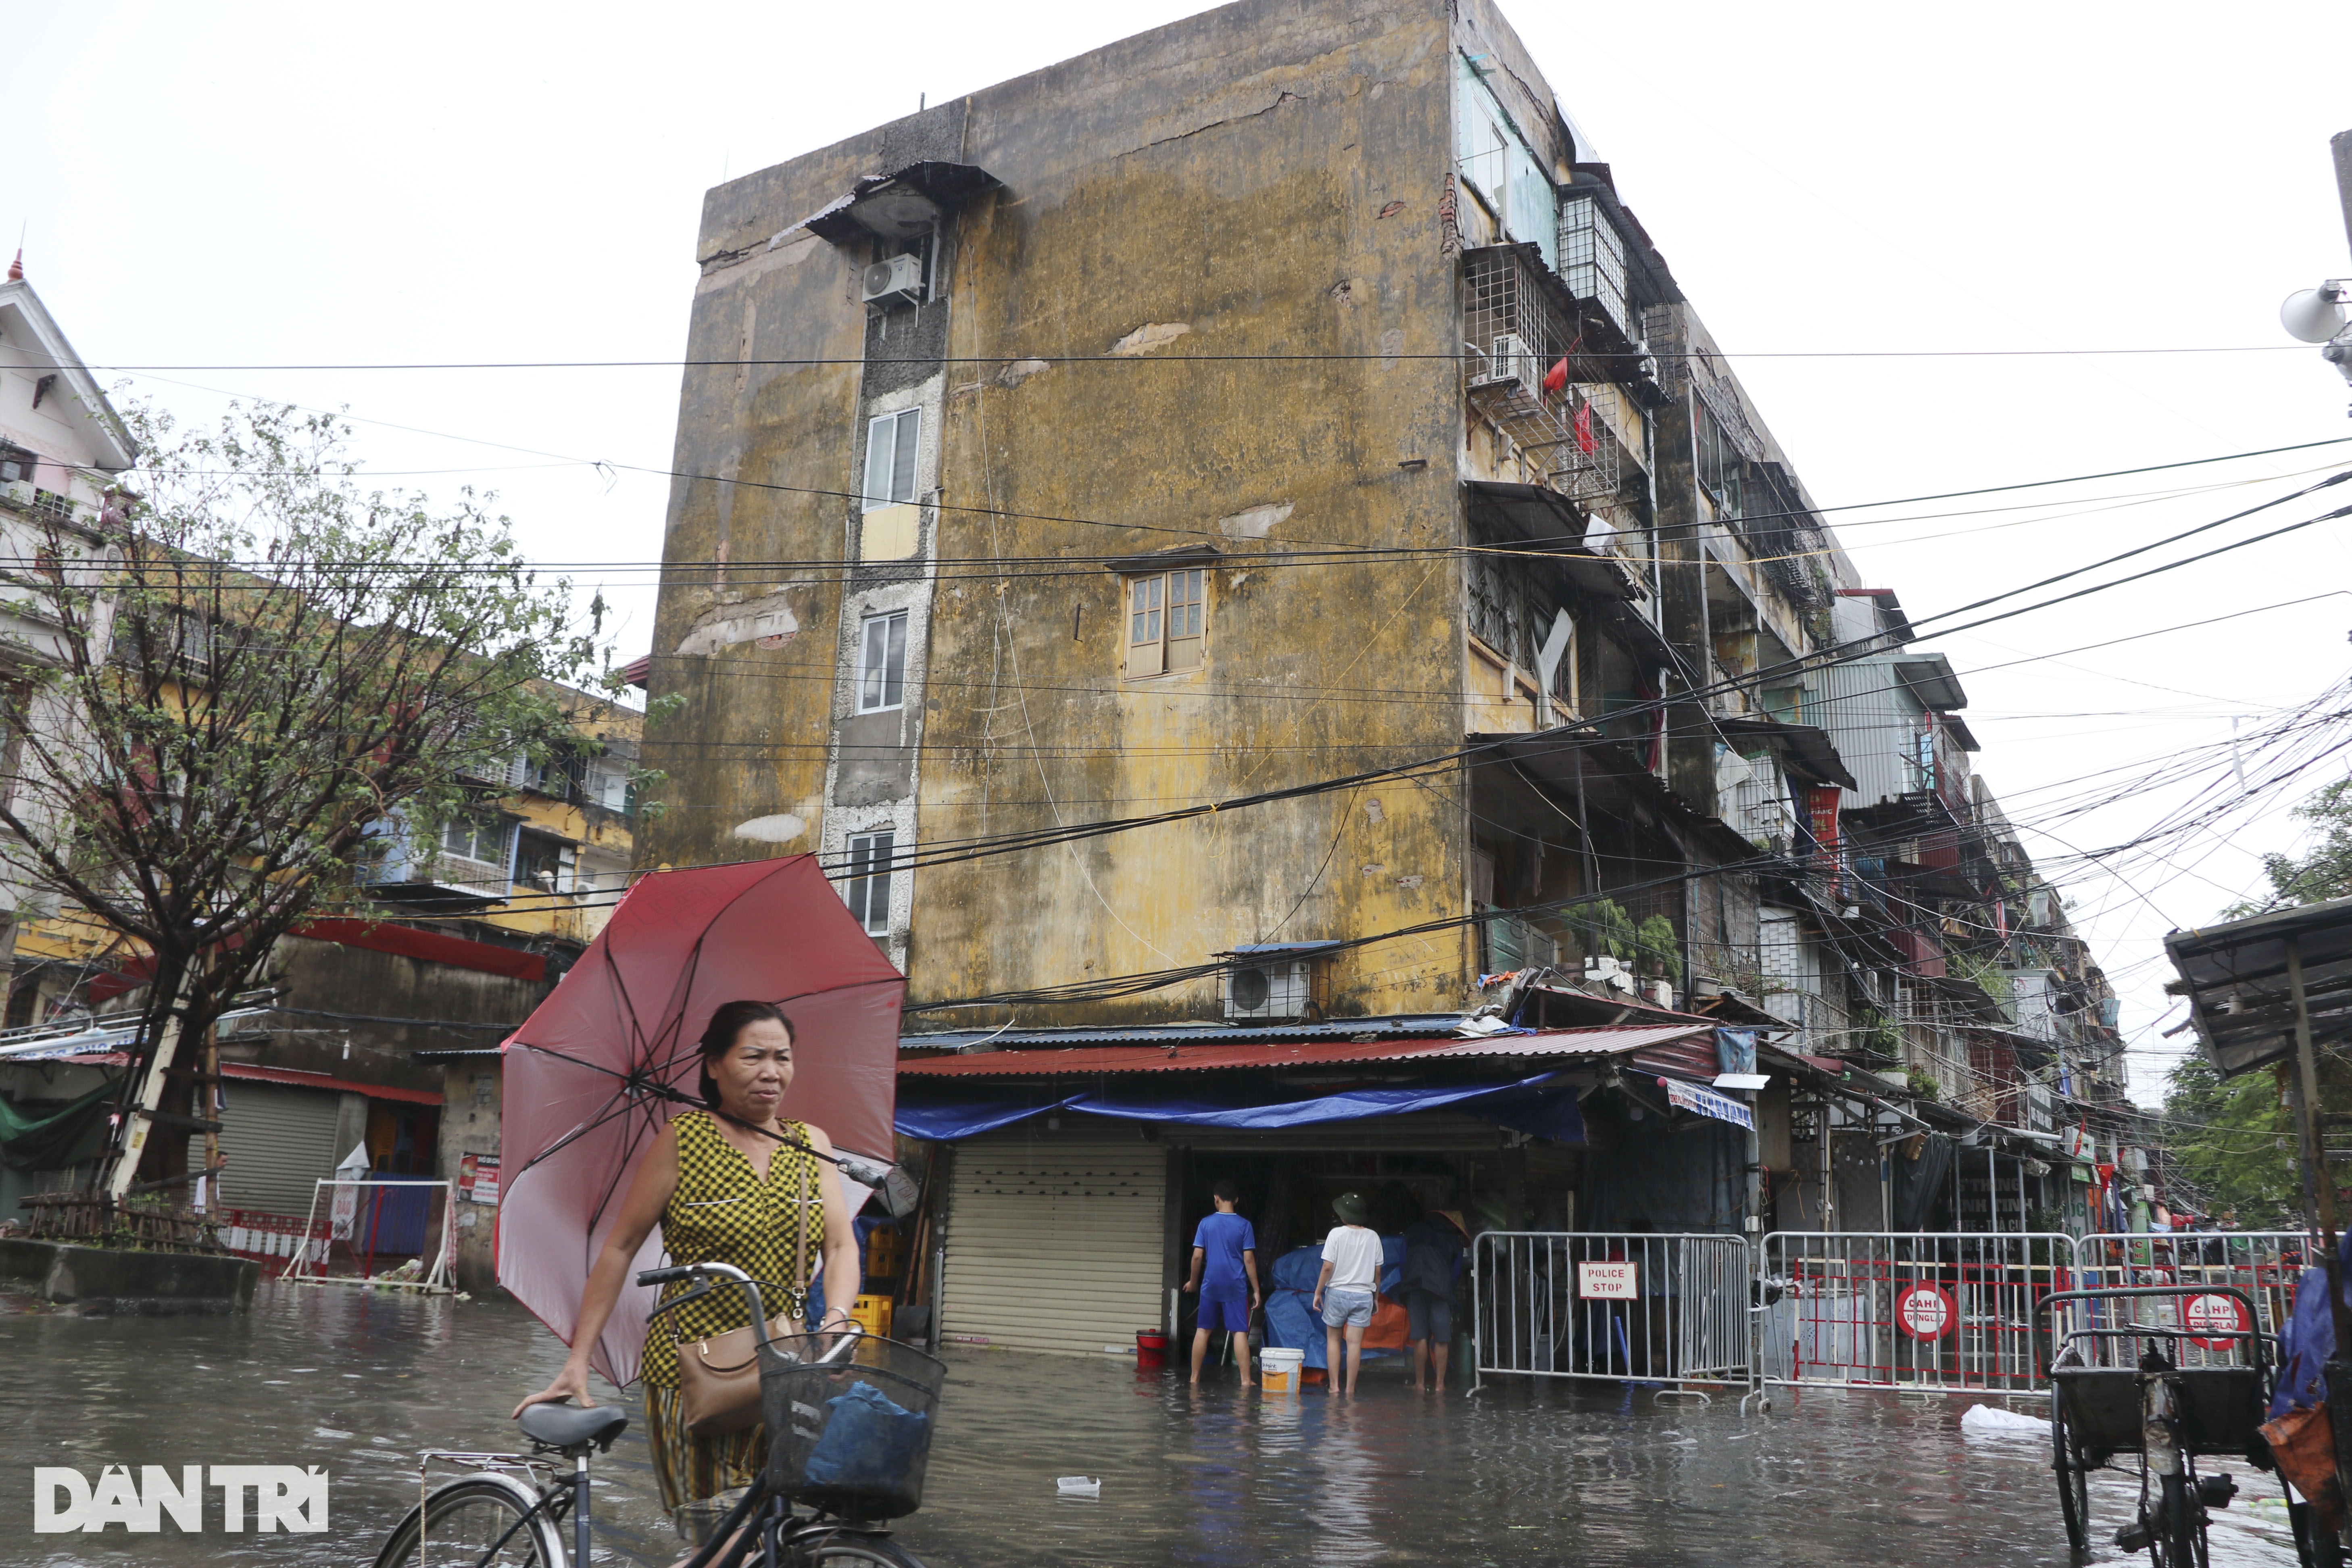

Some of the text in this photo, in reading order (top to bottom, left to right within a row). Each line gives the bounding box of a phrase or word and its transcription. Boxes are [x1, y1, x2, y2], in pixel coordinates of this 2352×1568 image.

[1947, 1199, 1987, 1212] LNH
[1588, 1269, 1624, 1278] POLICE
[1593, 1283, 1622, 1292] STOP
